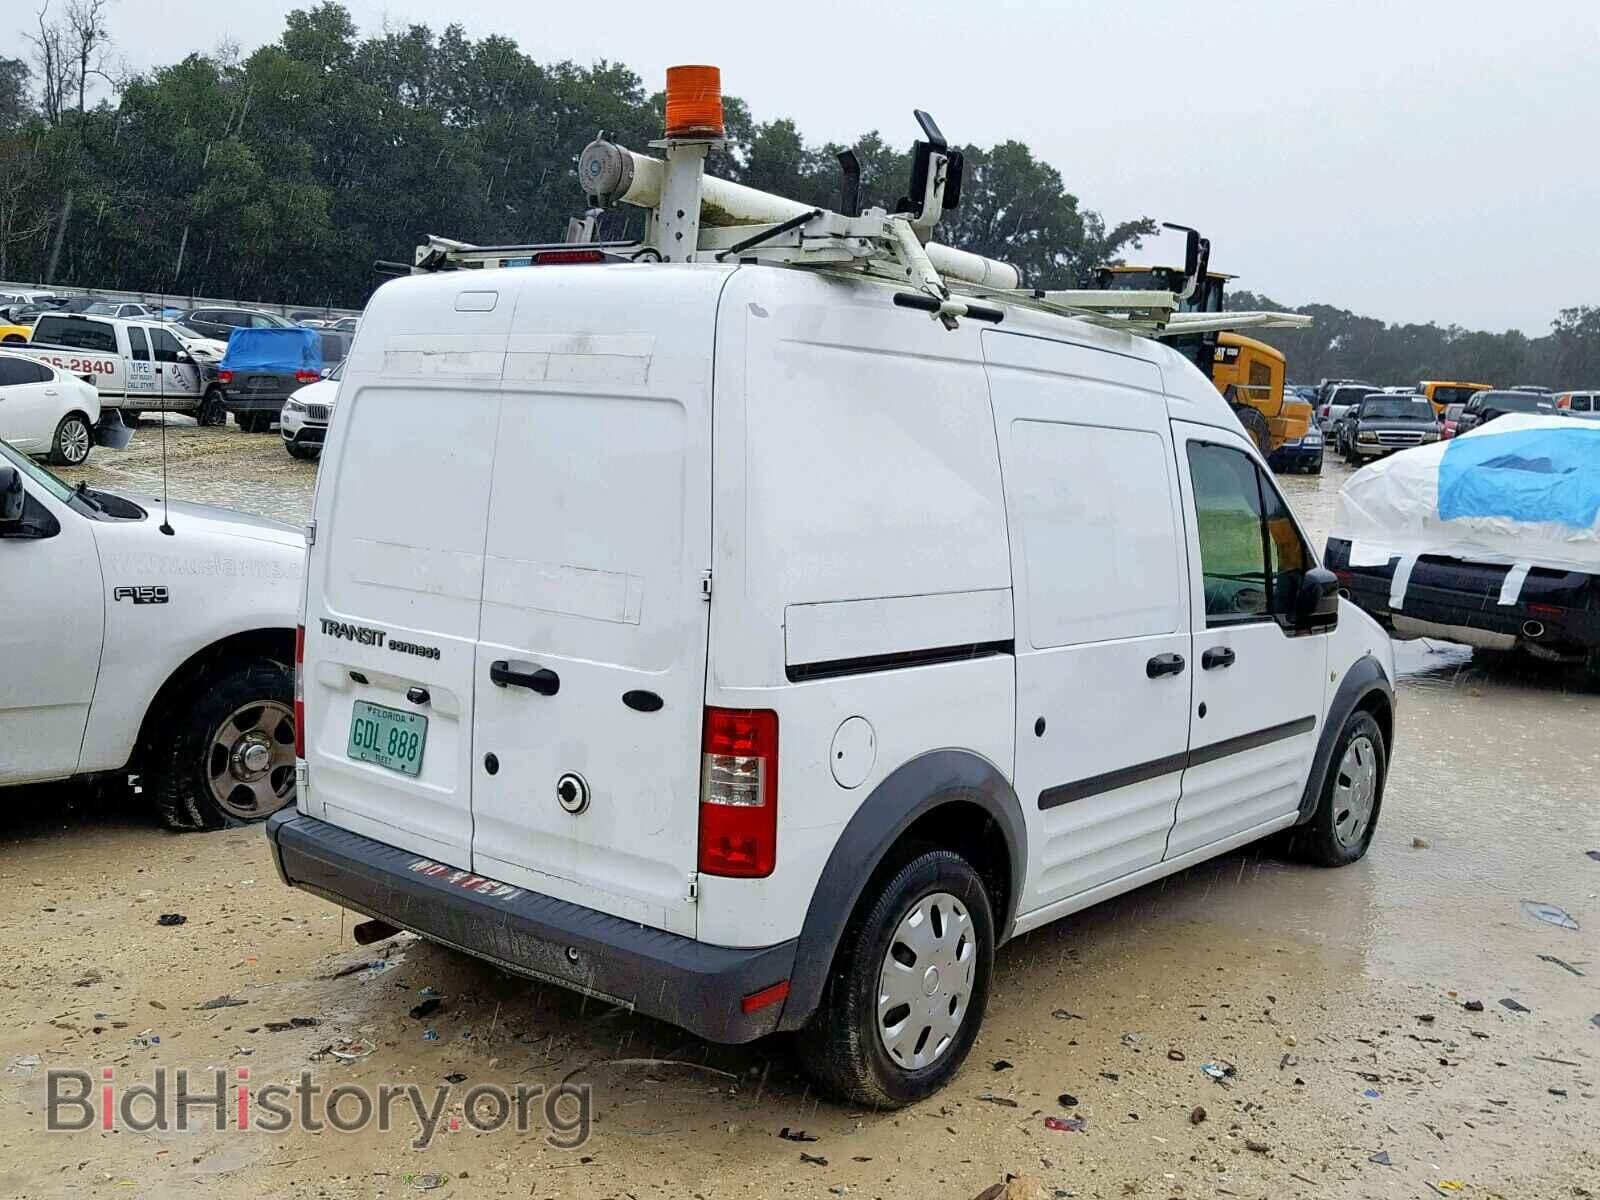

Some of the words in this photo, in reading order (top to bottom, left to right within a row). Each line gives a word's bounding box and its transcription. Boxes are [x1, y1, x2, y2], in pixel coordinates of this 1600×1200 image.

[319, 618, 387, 648] TRANSIT
[388, 639, 441, 661] connect
[372, 707, 407, 722] FLORIDA
[353, 717, 382, 753] GDL
[387, 727, 419, 762] 888
